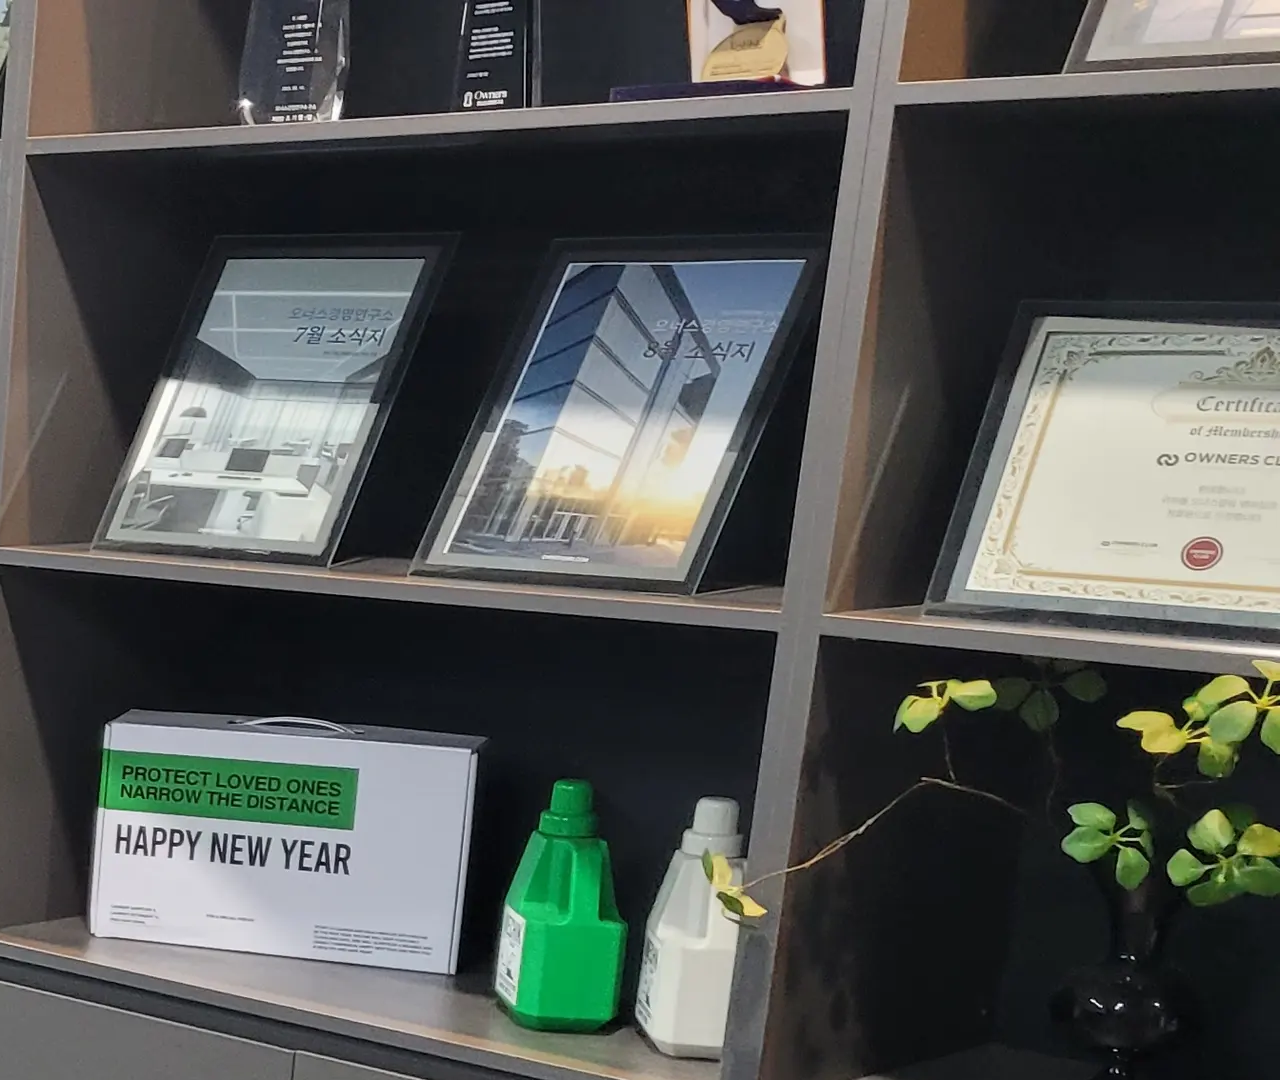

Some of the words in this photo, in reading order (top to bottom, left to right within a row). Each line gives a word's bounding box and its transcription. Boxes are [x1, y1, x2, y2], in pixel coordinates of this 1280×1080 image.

[293, 325, 326, 345] 7월
[326, 327, 387, 347] 소식지
[684, 340, 756, 363] 소식지
[1184, 452, 1261, 466] OWNERS
[121, 765, 212, 786] PROTECT
[215, 772, 281, 792] LOVED
[286, 778, 342, 797] ONES
[120, 784, 202, 805] NARROW
[206, 791, 242, 808] THE
[246, 795, 341, 816] DISTANCE
[115, 823, 202, 861] HAPPY
[209, 832, 272, 867] NEW
[281, 838, 352, 876] YEAR
